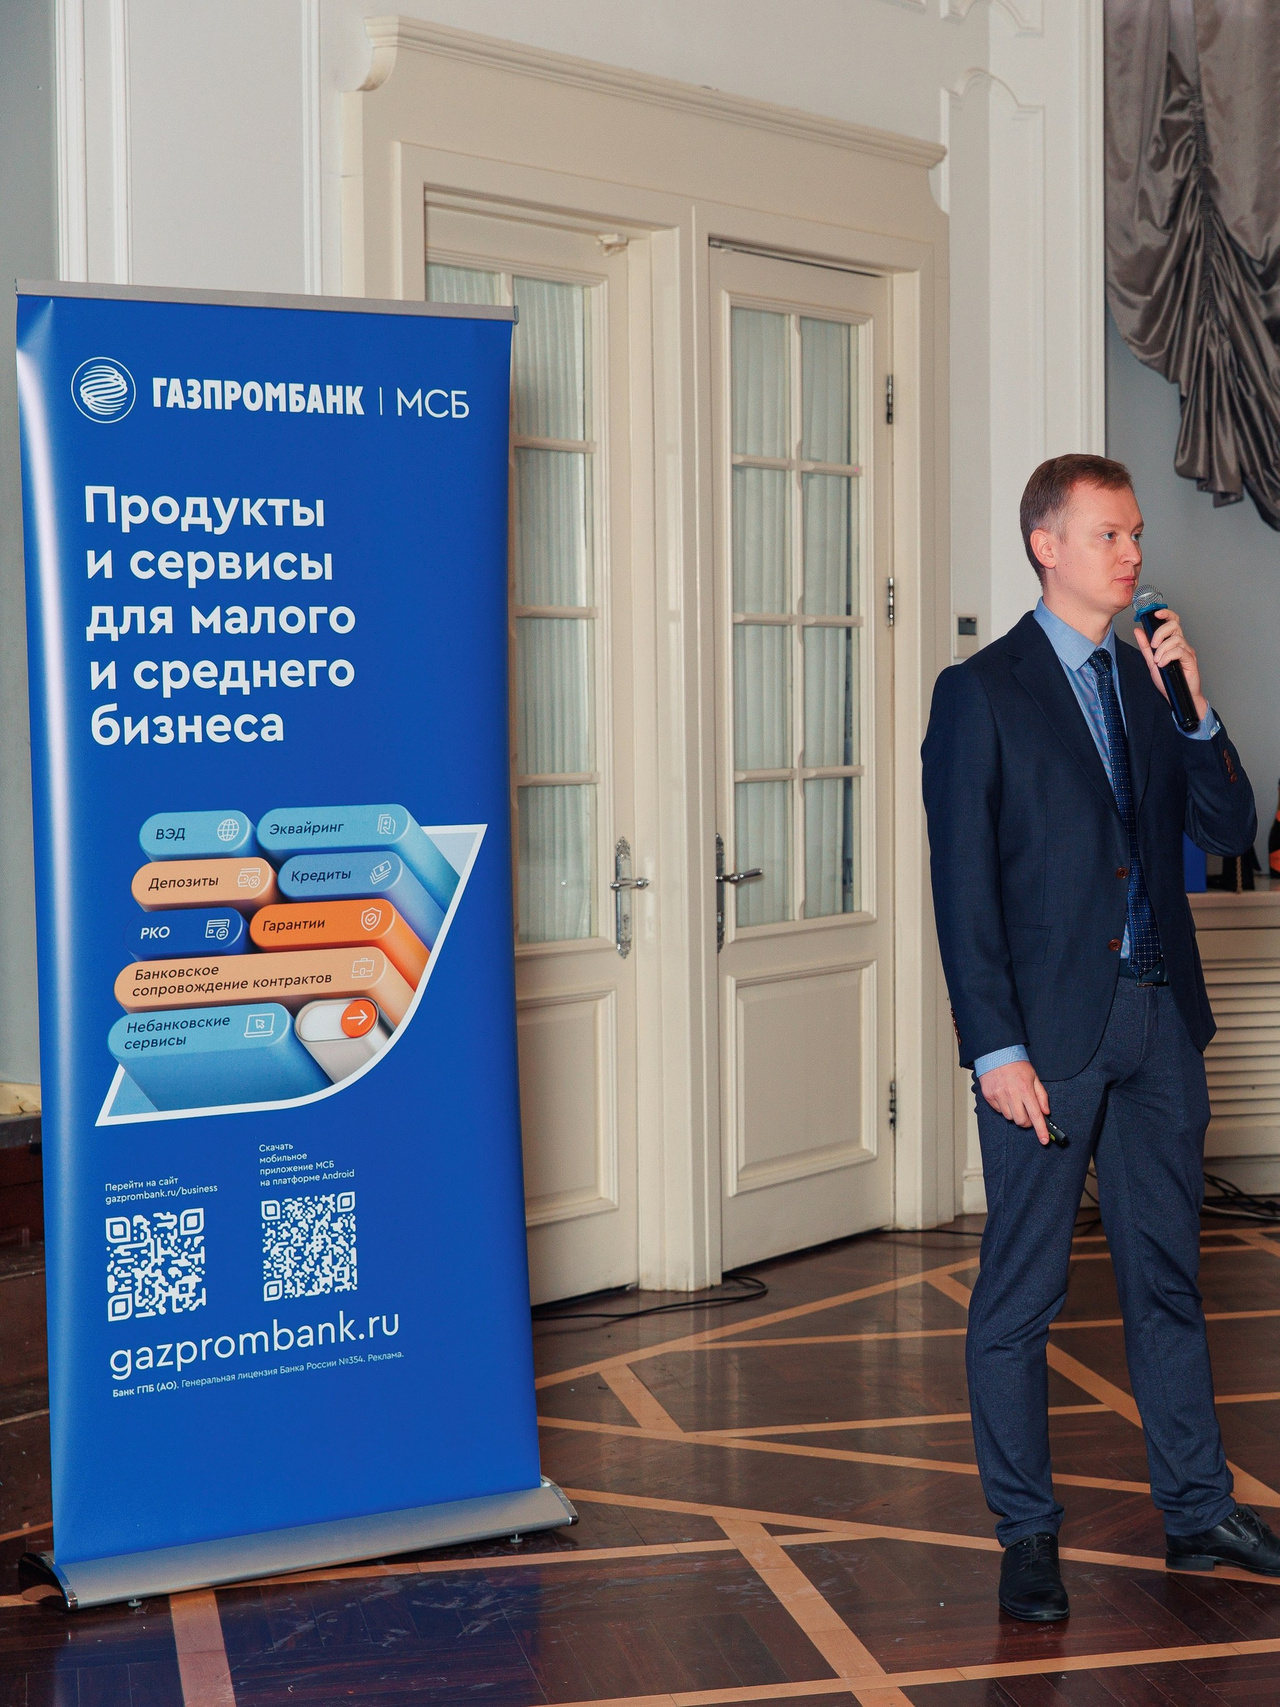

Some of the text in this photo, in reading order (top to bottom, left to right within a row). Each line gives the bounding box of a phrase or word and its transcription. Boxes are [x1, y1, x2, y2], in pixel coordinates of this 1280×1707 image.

[151, 376, 470, 418] ГАЗПРОМБАНК МСБ
[85, 485, 325, 535] Продукты
[87, 550, 333, 588] и сервисы
[86, 605, 356, 642] для малого
[90, 659, 355, 698] и среднего
[91, 704, 284, 746] бизнеса
[155, 827, 186, 841] ВЭД
[269, 822, 344, 836] Эквайринг
[148, 875, 219, 891] Депозиты
[291, 869, 352, 883] Кредиты
[140, 926, 170, 939] РКО
[262, 918, 325, 933] Гарантии
[135, 965, 220, 981] Банковское
[132, 973, 333, 997] сопровождение контрактов
[126, 1014, 231, 1034] Небанковские
[124, 1035, 187, 1051] сервисы
[259, 1143, 293, 1152] Скачать
[260, 1153, 307, 1163] мобильное
[260, 1160, 334, 1176] приложение МСБ
[105, 1177, 179, 1192] Перейти на сайт
[273, 1174, 320, 1185] платформе
[322, 1169, 355, 1180] Android
[105, 1184, 218, 1205] gazprombank.ru/business
[110, 1310, 399, 1380] gazprombank.ru
[113, 1352, 404, 1397] Банк ГПБ (АО). Генеральная лицензия Банка России №354. Реклама.
